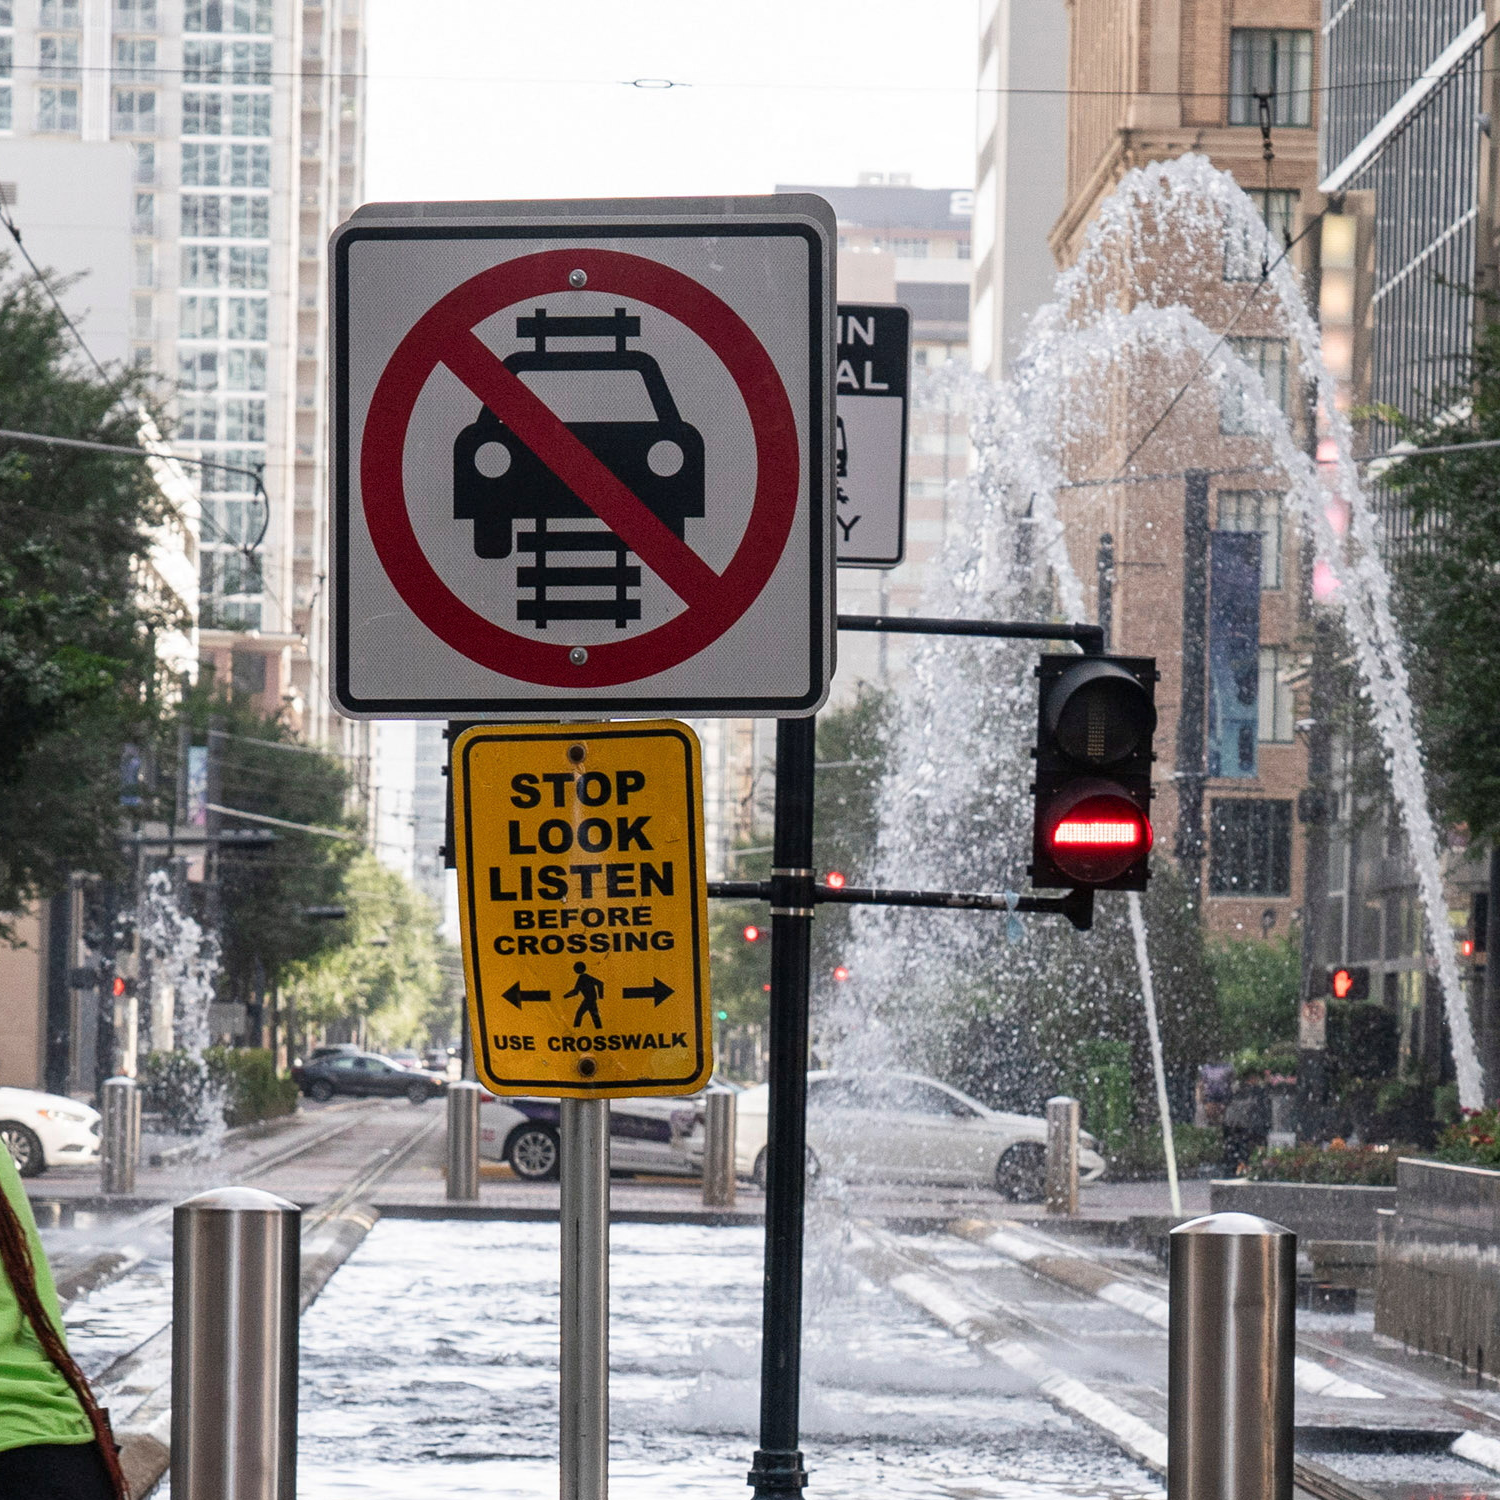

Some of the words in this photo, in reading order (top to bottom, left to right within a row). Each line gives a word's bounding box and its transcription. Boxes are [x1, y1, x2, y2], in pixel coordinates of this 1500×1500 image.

[510, 770, 647, 810] STOP
[508, 815, 654, 856] LOOK
[489, 861, 675, 902] LISTEN
[513, 905, 653, 930] BEFORE
[493, 930, 675, 956] CROSSING
[493, 1034, 536, 1051] USE
[547, 1032, 688, 1052] CROSSWALK
